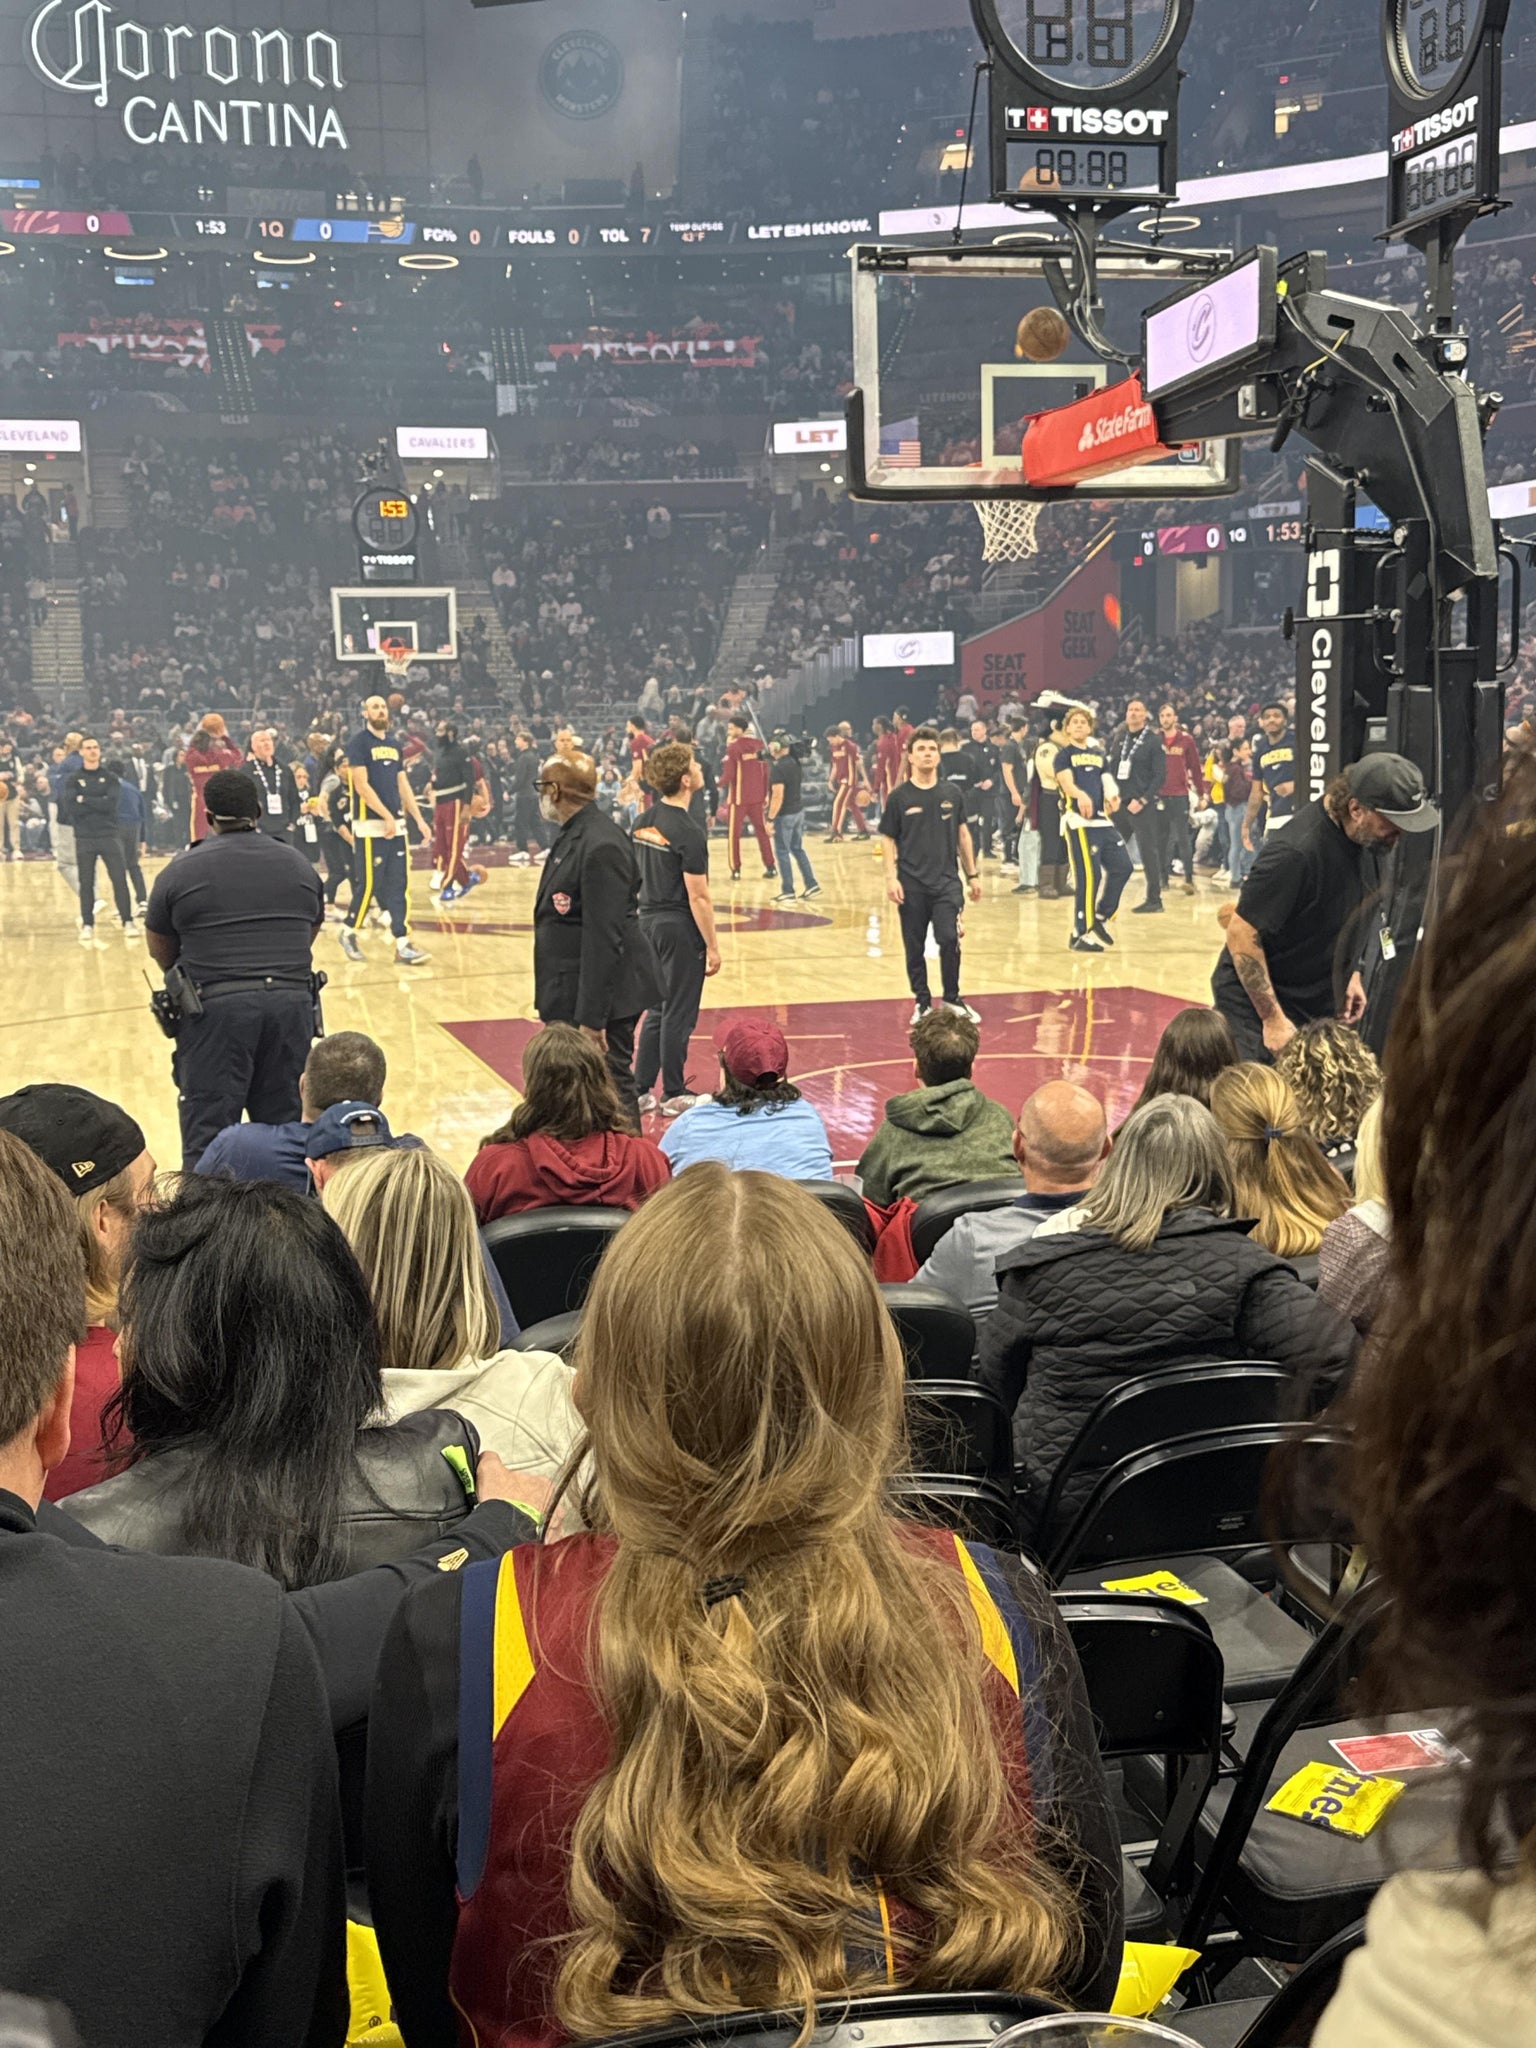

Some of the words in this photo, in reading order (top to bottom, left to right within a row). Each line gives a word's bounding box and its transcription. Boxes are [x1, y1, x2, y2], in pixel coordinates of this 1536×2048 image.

[31, 0, 344, 107] Corona
[124, 96, 347, 149] CANTINA
[1051, 107, 1169, 135] TISSOT
[1414, 96, 1478, 145] TISSOT
[86, 215, 99, 232] 0
[196, 220, 226, 235] 1:53
[259, 221, 284, 238] 1Q
[319, 223, 332, 239] 0
[748, 225, 782, 239] LET
[784, 224, 811, 237] EM
[812, 219, 872, 236] KNOW.
[423, 227, 457, 242] FG%
[469, 229, 481, 245] 0
[508, 229, 556, 244] FOULS
[568, 229, 579, 245] 0
[600, 229, 630, 243] TOL
[640, 228, 651, 243] 7
[409, 437, 475, 448] CAVALIERS
[795, 429, 838, 444] LET
[380, 501, 408, 517] 1:53
[1206, 527, 1220, 548] 0
[1229, 528, 1247, 542] 1Q
[1266, 521, 1300, 542] 1:53
[1144, 541, 1154, 555] 0
[1063, 610, 1095, 633] SEAT
[1062, 636, 1096, 659] GEEK
[984, 653, 1026, 671] SEAT
[981, 673, 1027, 690] GEEK
[1309, 628, 1332, 802] Clevelan
